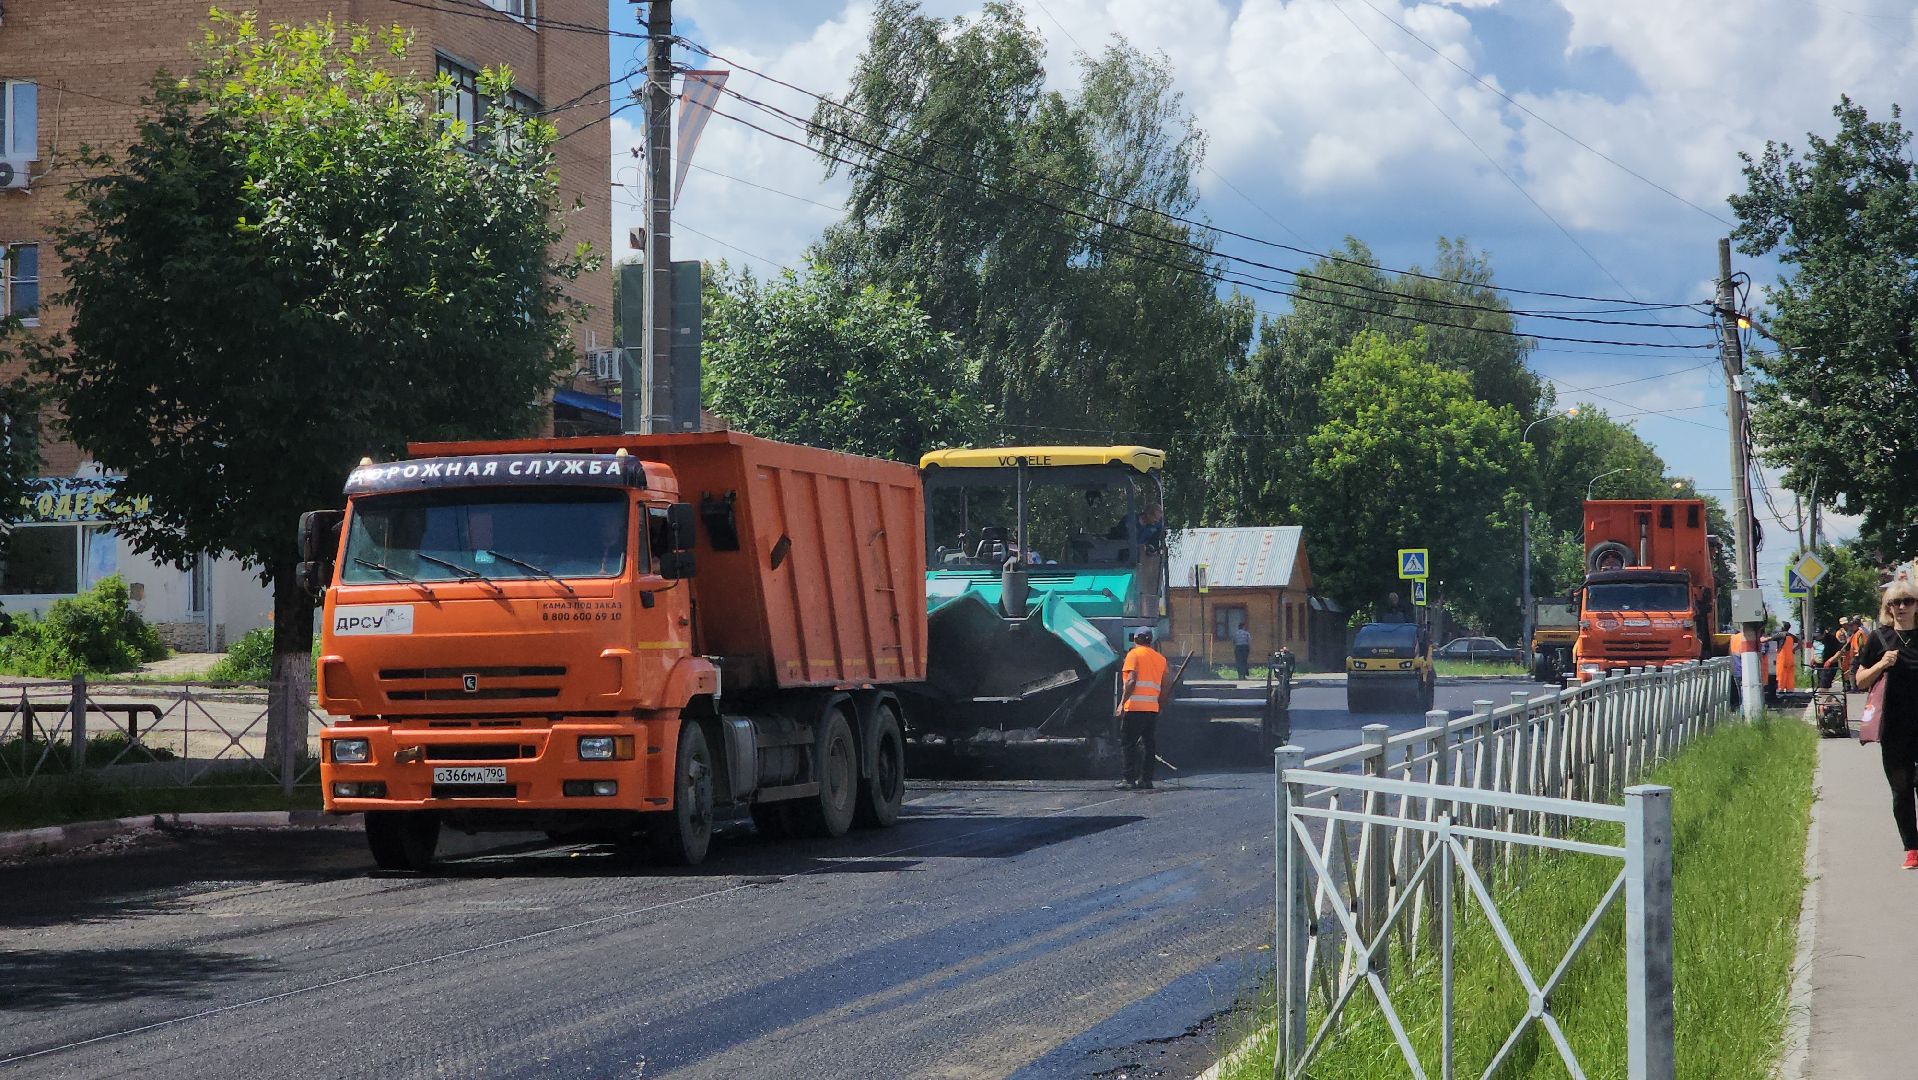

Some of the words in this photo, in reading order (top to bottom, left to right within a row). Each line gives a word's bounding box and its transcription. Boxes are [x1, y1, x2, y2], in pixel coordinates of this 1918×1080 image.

[998, 453, 1052, 466] VÖELE
[347, 461, 498, 487] ДОРОЖНАЯ
[508, 460, 621, 475] СЛУЖБА
[543, 602, 572, 610] КАМАЗ
[336, 616, 383, 630] ДРСУ
[552, 613, 570, 621] 800
[573, 613, 592, 621] 600
[595, 612, 607, 620] 69
[611, 612, 622, 620] 10
